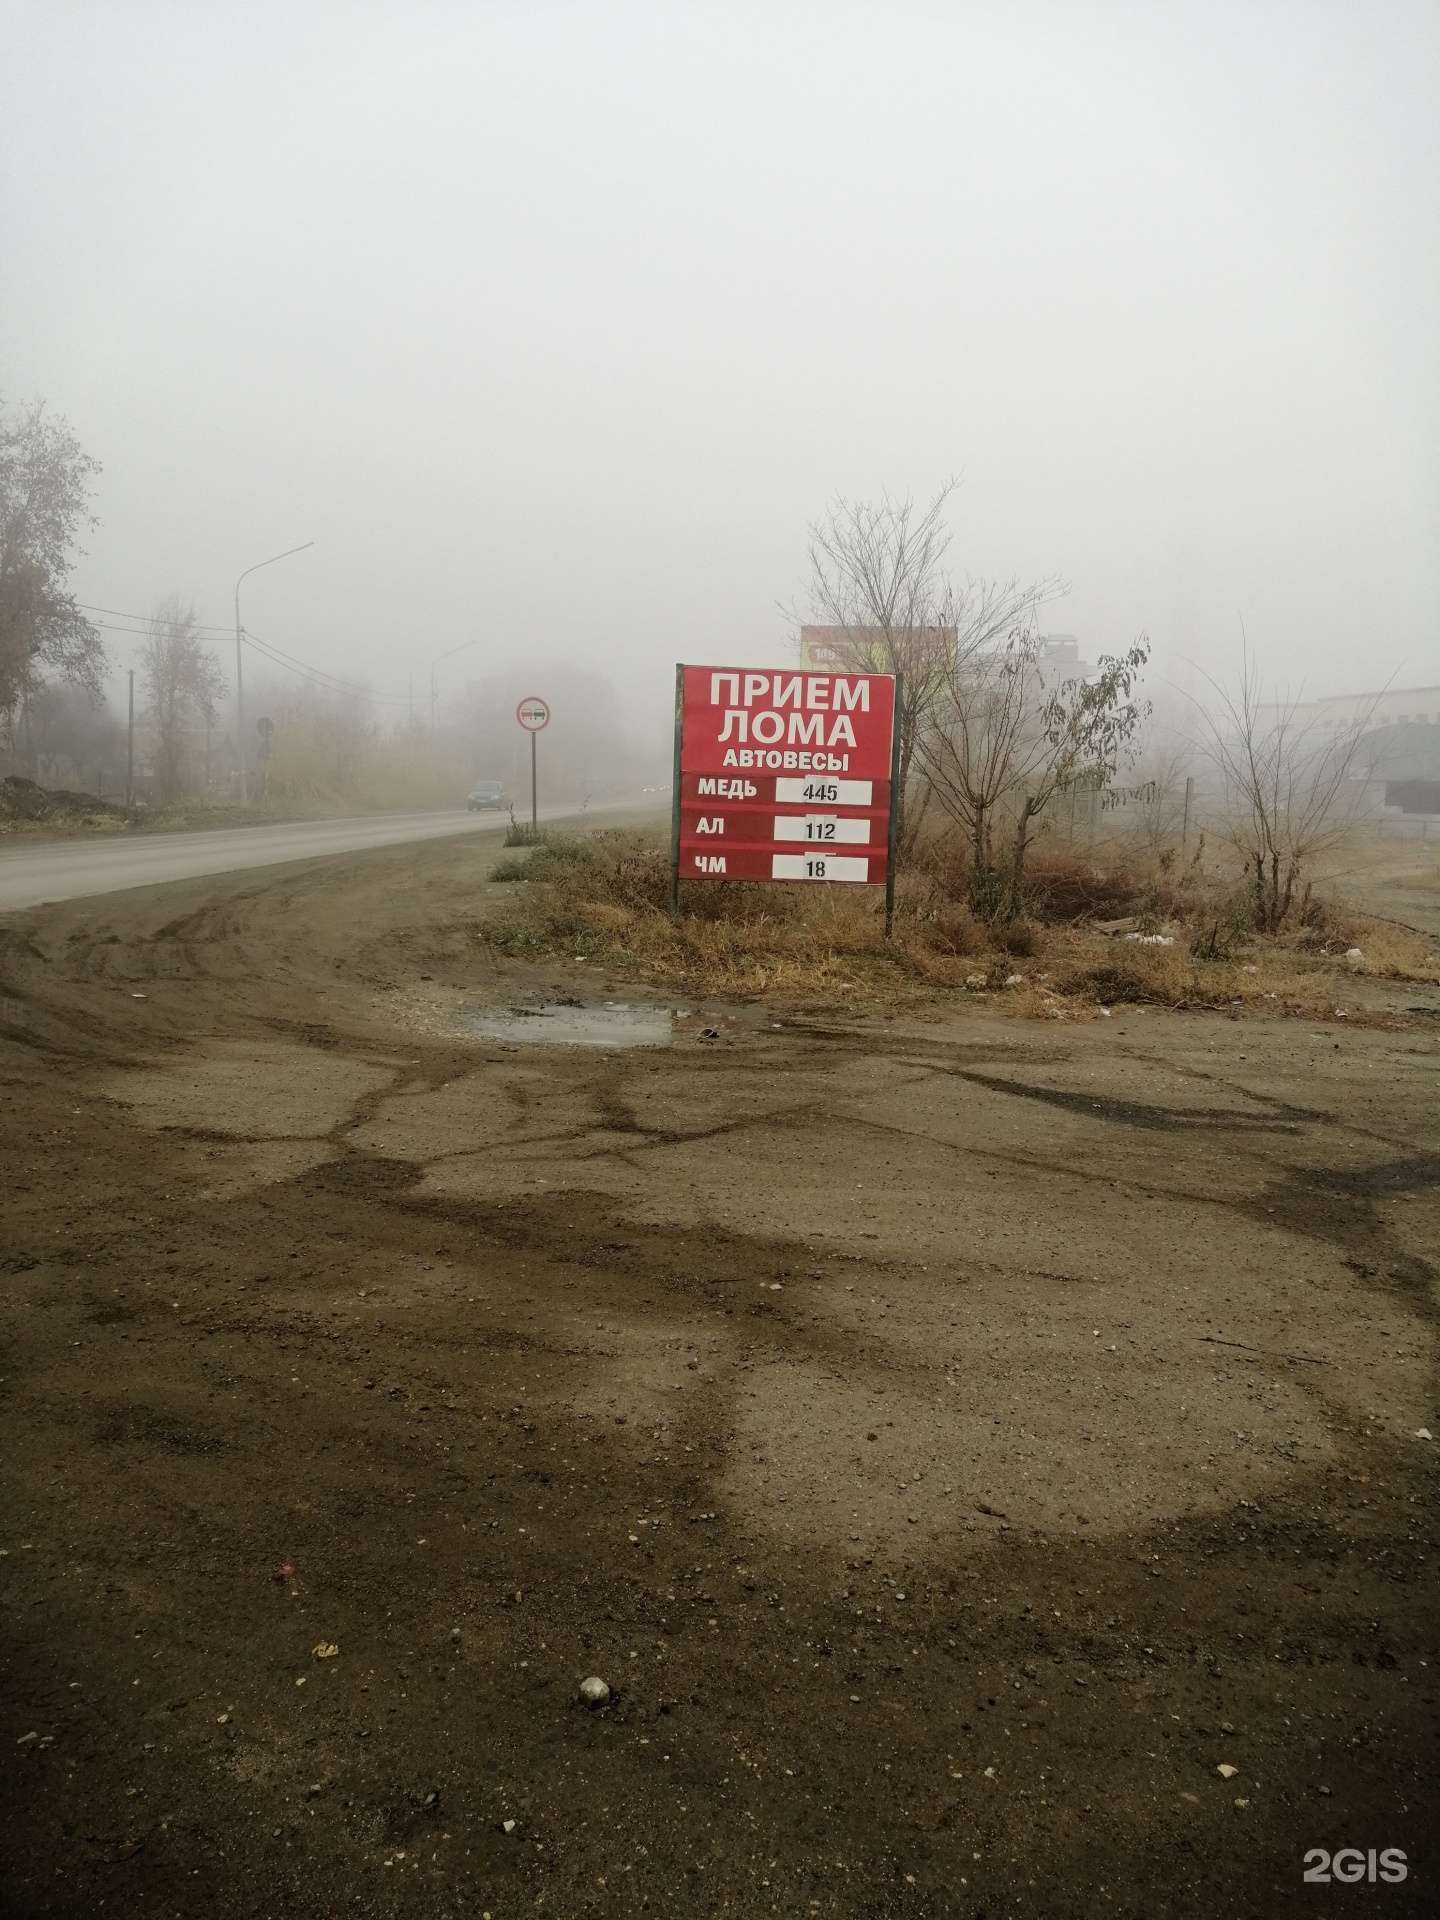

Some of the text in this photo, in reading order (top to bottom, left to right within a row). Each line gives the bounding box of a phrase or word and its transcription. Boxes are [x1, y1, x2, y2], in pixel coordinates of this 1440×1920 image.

[710, 673, 870, 712] ПРИЕМ
[717, 710, 857, 748] ЛОМА
[722, 749, 849, 771] АВТОВЕСЫ
[698, 778, 838, 801] МЕДЬ 445
[696, 817, 836, 839] АЛ 112
[695, 856, 826, 877] ЧМ 18
